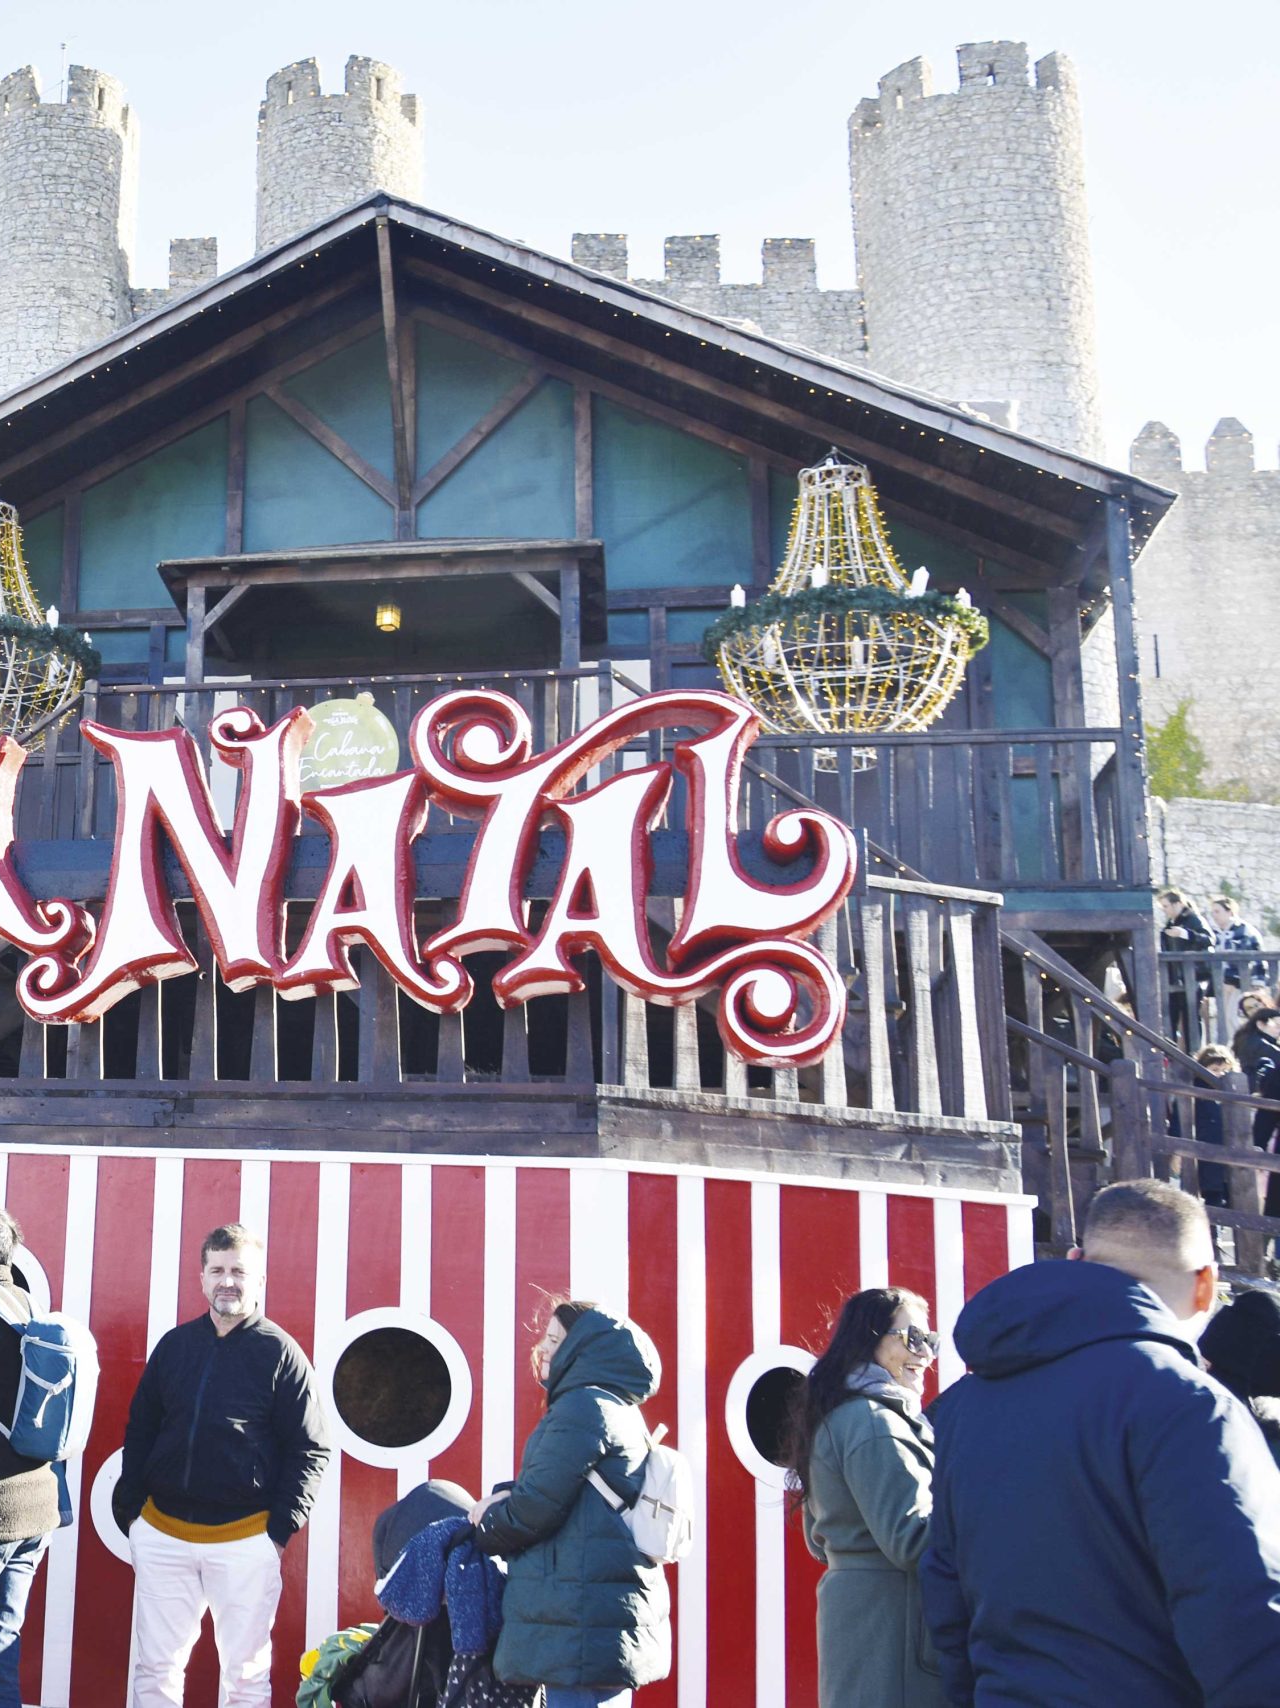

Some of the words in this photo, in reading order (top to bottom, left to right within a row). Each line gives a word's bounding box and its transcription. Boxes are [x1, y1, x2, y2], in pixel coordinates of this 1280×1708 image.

[314, 730, 384, 761] Cabana
[299, 756, 386, 782] Encantada
[17, 689, 859, 1067] NATAL
